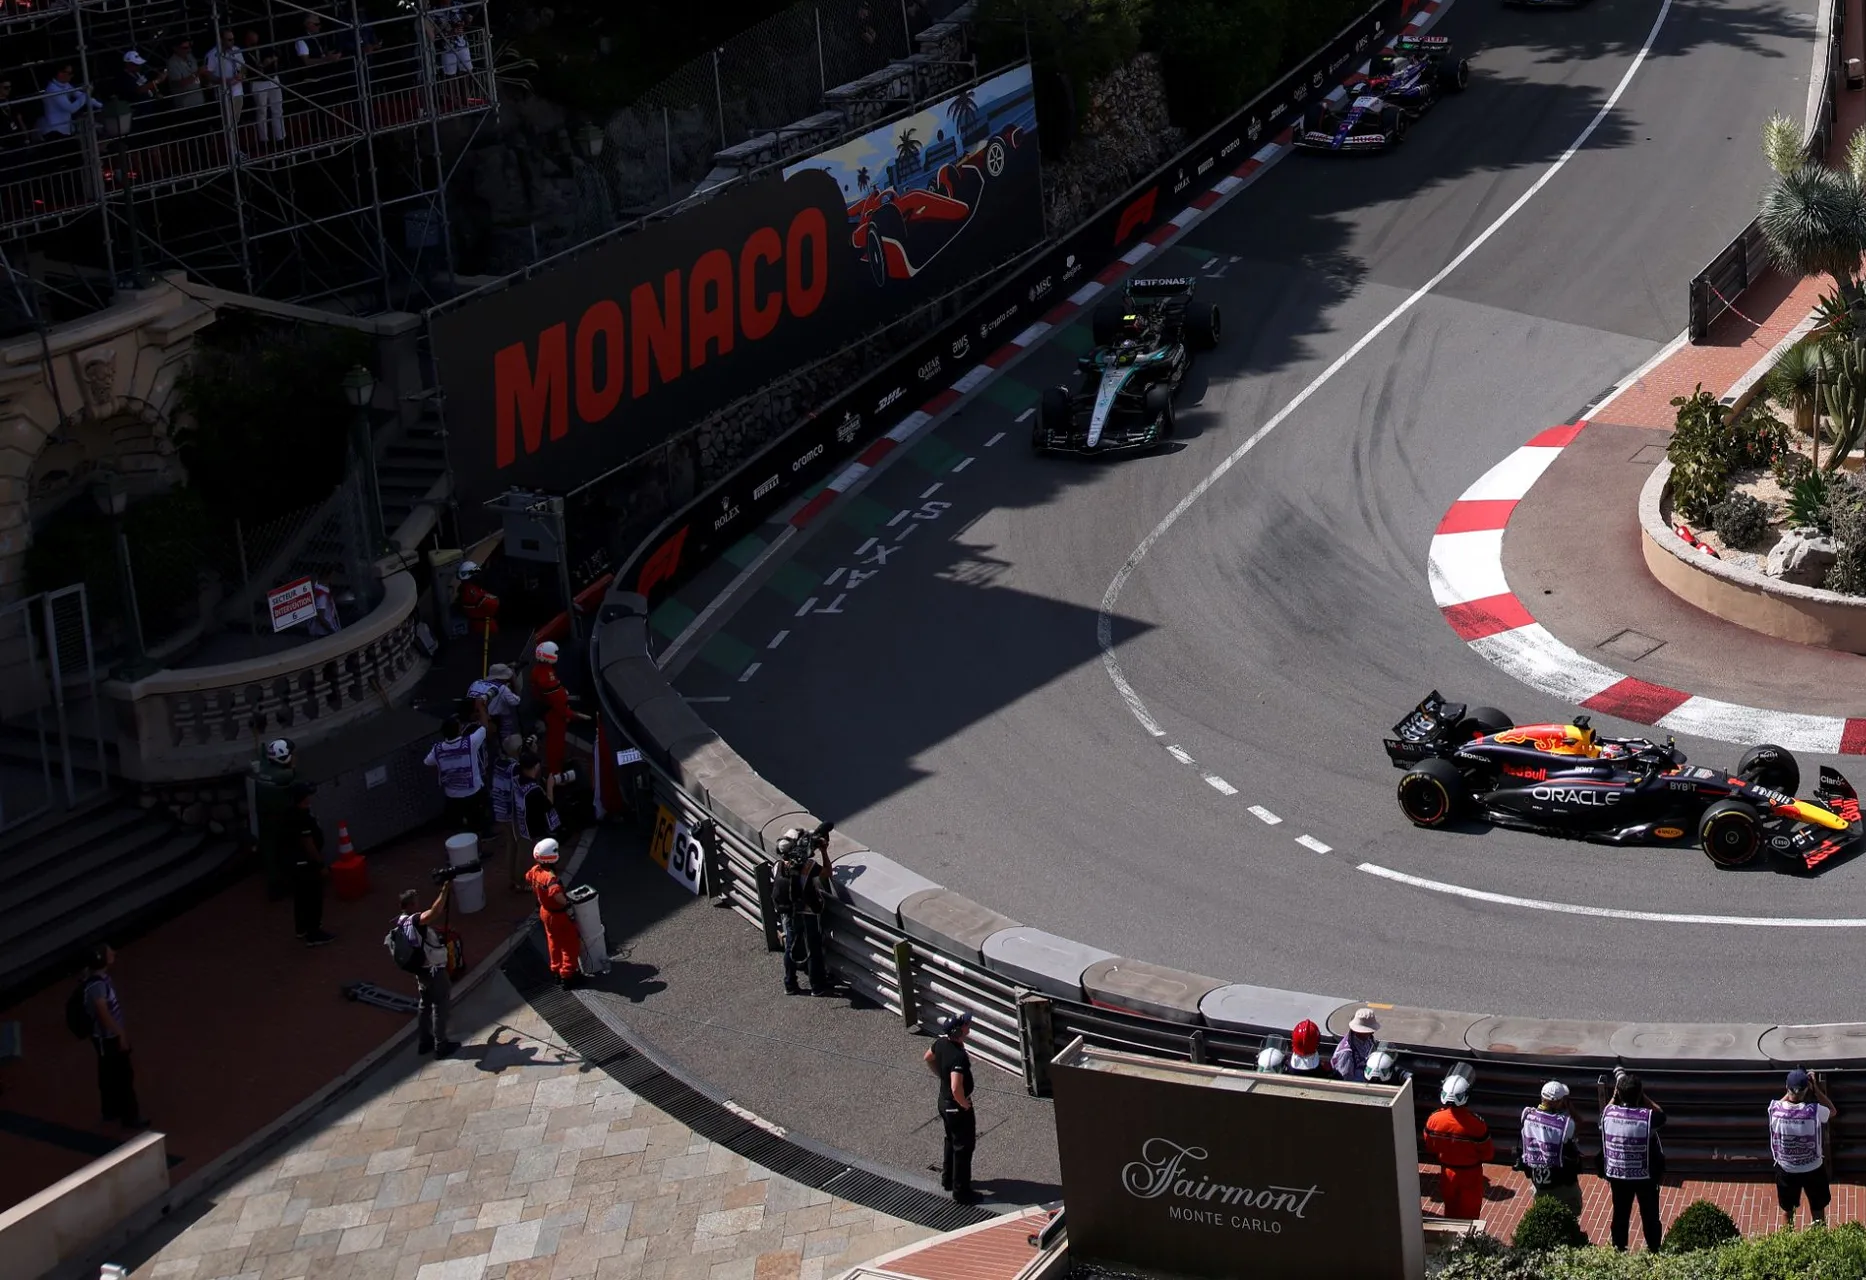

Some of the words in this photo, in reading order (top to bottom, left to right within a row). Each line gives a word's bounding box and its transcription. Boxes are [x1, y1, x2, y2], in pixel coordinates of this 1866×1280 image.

[1035, 276, 1052, 296] MSC
[1134, 278, 1186, 287] PETRONAS
[988, 304, 1019, 332] crypto.com
[493, 206, 829, 469] MONACO
[953, 333, 969, 353] aws
[918, 355, 941, 380] QATAR
[874, 387, 907, 415] DHL
[792, 443, 824, 472] aramco
[753, 474, 780, 501] PIRELLI
[714, 503, 741, 531] ROLEX
[272, 589, 298, 606] SECTEUR
[302, 585, 308, 593] 6
[274, 595, 312, 618] INTERVENTION
[292, 612, 298, 620] 6
[1461, 751, 1492, 763] HONDA
[1503, 763, 1523, 778] Red
[1524, 766, 1546, 781] Bull
[1820, 775, 1842, 786] Claro
[1532, 786, 1621, 806] ORACLE
[1669, 781, 1698, 792] BYBIT
[656, 821, 673, 861] FC
[673, 832, 699, 882] SC
[1121, 1137, 1325, 1218] Fairmont
[1169, 1206, 1224, 1226] MONTE
[1231, 1216, 1282, 1234] CARLO
